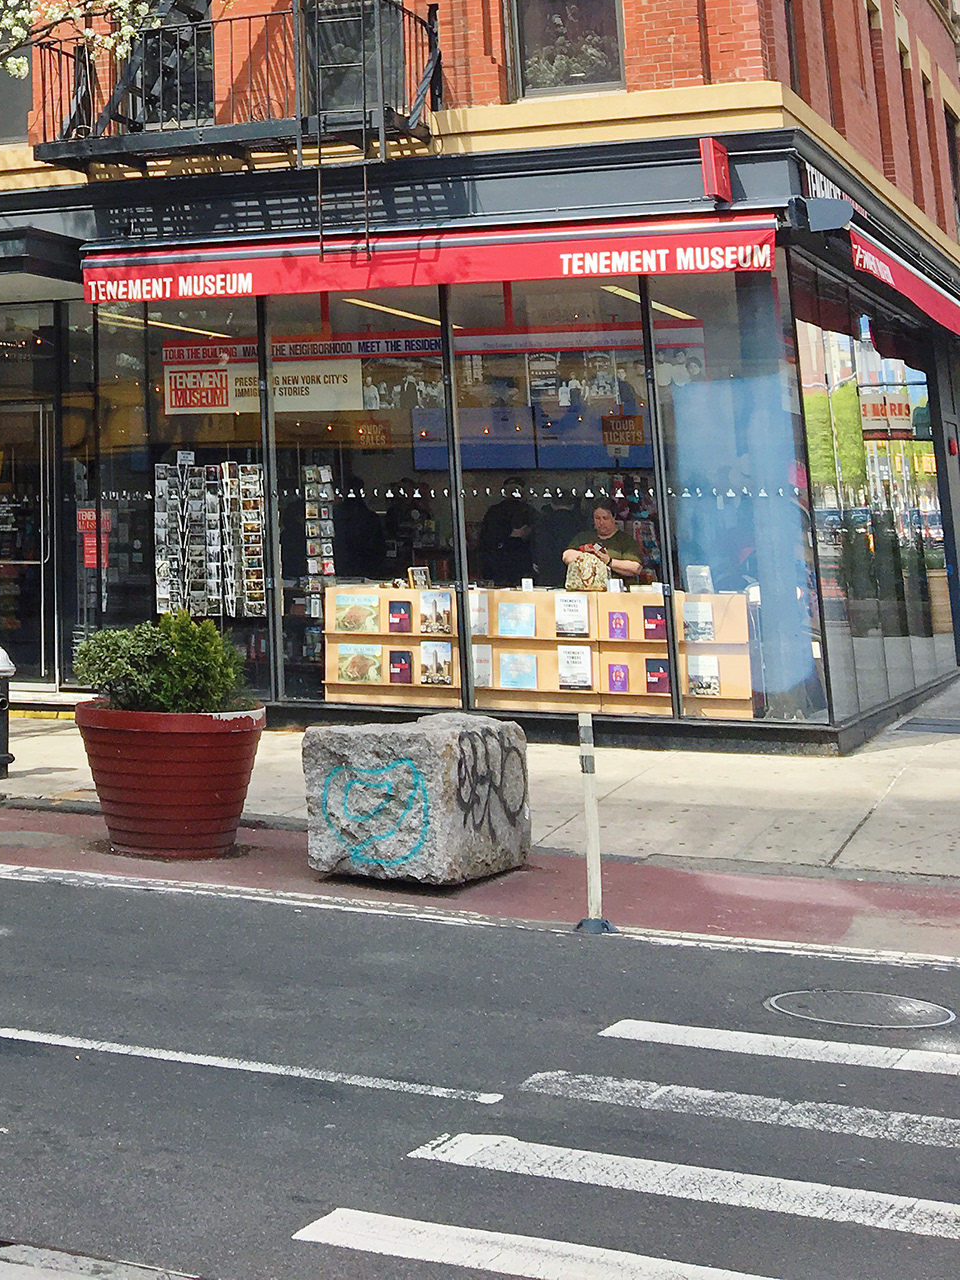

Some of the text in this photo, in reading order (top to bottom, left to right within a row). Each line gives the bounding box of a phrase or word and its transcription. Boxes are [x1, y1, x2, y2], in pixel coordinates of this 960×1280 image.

[560, 244, 771, 275] TENEMENT MUSEUM
[88, 272, 253, 301] TENEMENT MUSEUM
[164, 348, 184, 360] TOUR
[186, 347, 200, 359] THE
[202, 346, 237, 359] BUILDING
[271, 344, 286, 356] THE
[290, 342, 352, 356] NEIGHBORHOOD
[358, 341, 381, 353] MEET
[385, 340, 402, 352] THE
[405, 338, 442, 351] RESIDEN
[169, 371, 228, 389] TENEMENT
[282, 375, 299, 385] NEW
[301, 374, 321, 385] YORK
[323, 374, 348, 384] CITY'S
[171, 389, 228, 407] MUSEUM
[278, 387, 310, 397] STORIES
[610, 420, 635, 430] TOUR
[360, 435, 386, 446] SALES
[604, 431, 643, 442] TICKETS
